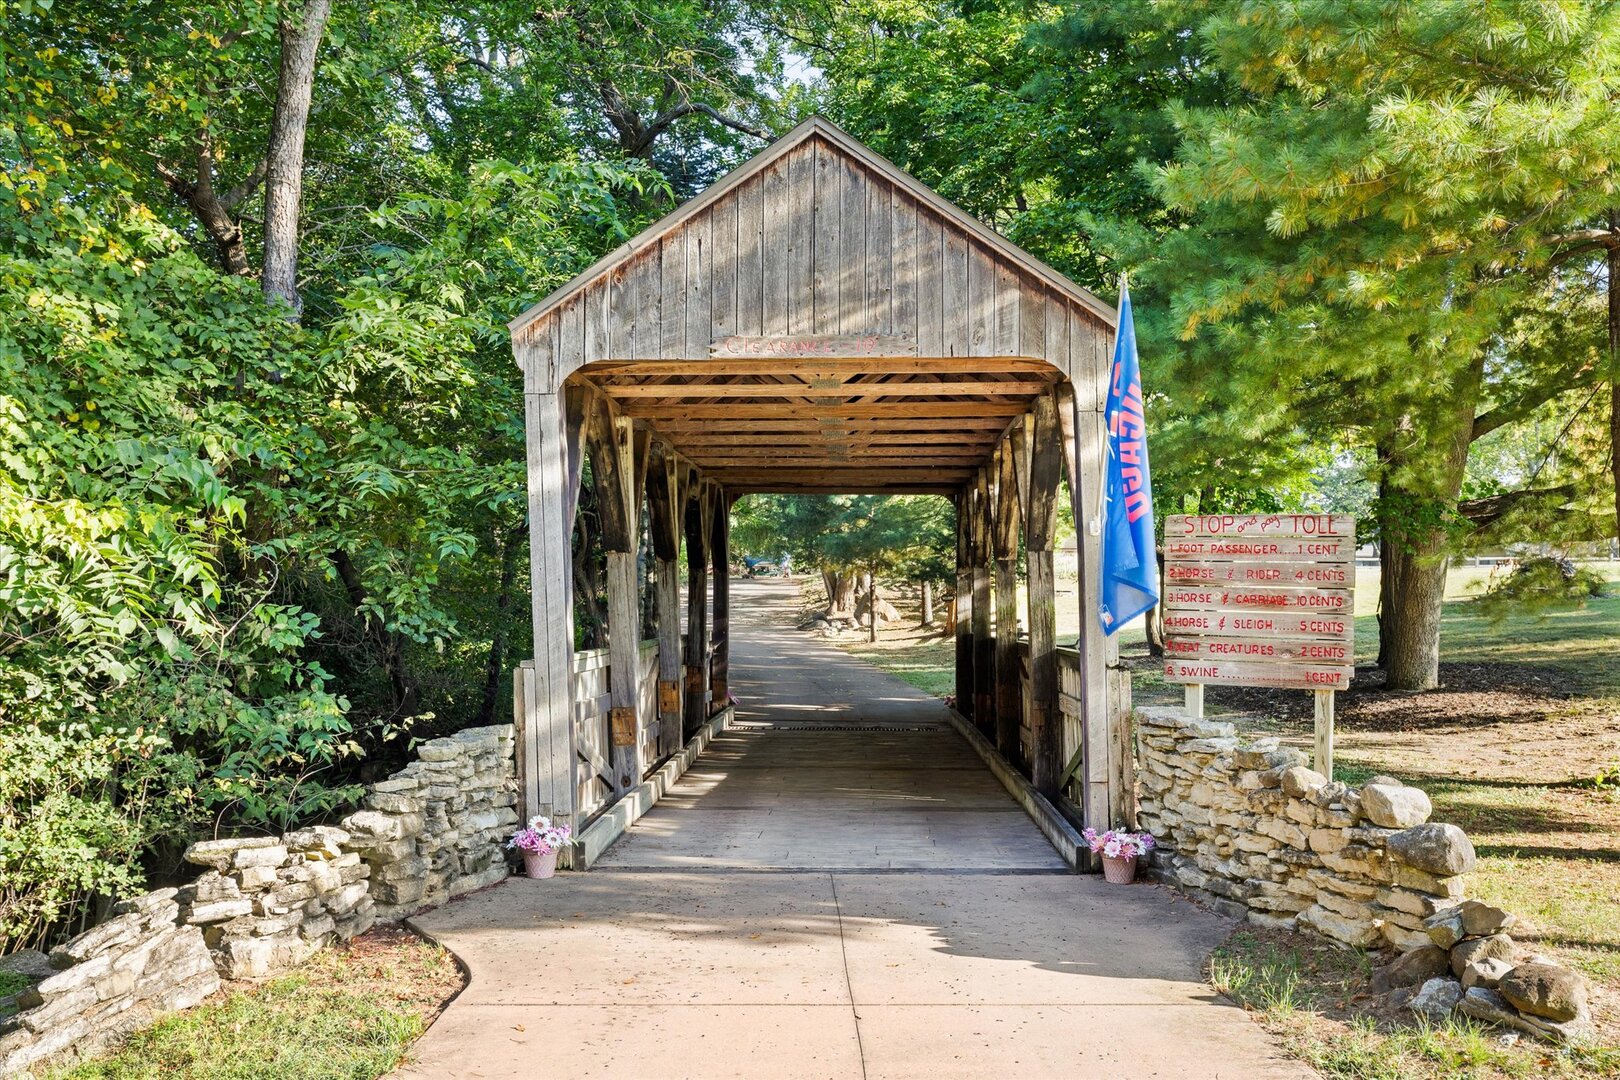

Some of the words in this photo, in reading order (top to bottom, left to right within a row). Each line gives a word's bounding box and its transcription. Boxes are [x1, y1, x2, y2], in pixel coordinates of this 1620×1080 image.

[1184, 515, 1234, 533] STOP
[1237, 515, 1257, 533] and
[1260, 515, 1280, 532] pay
[1289, 515, 1338, 534] TOLL
[1307, 544, 1339, 555] CENT
[1307, 570, 1345, 581] CENTS
[1309, 595, 1343, 607] CENTS
[1310, 621, 1344, 632] CENTS
[1310, 646, 1345, 658] CENTS
[1312, 672, 1341, 683] CENT
